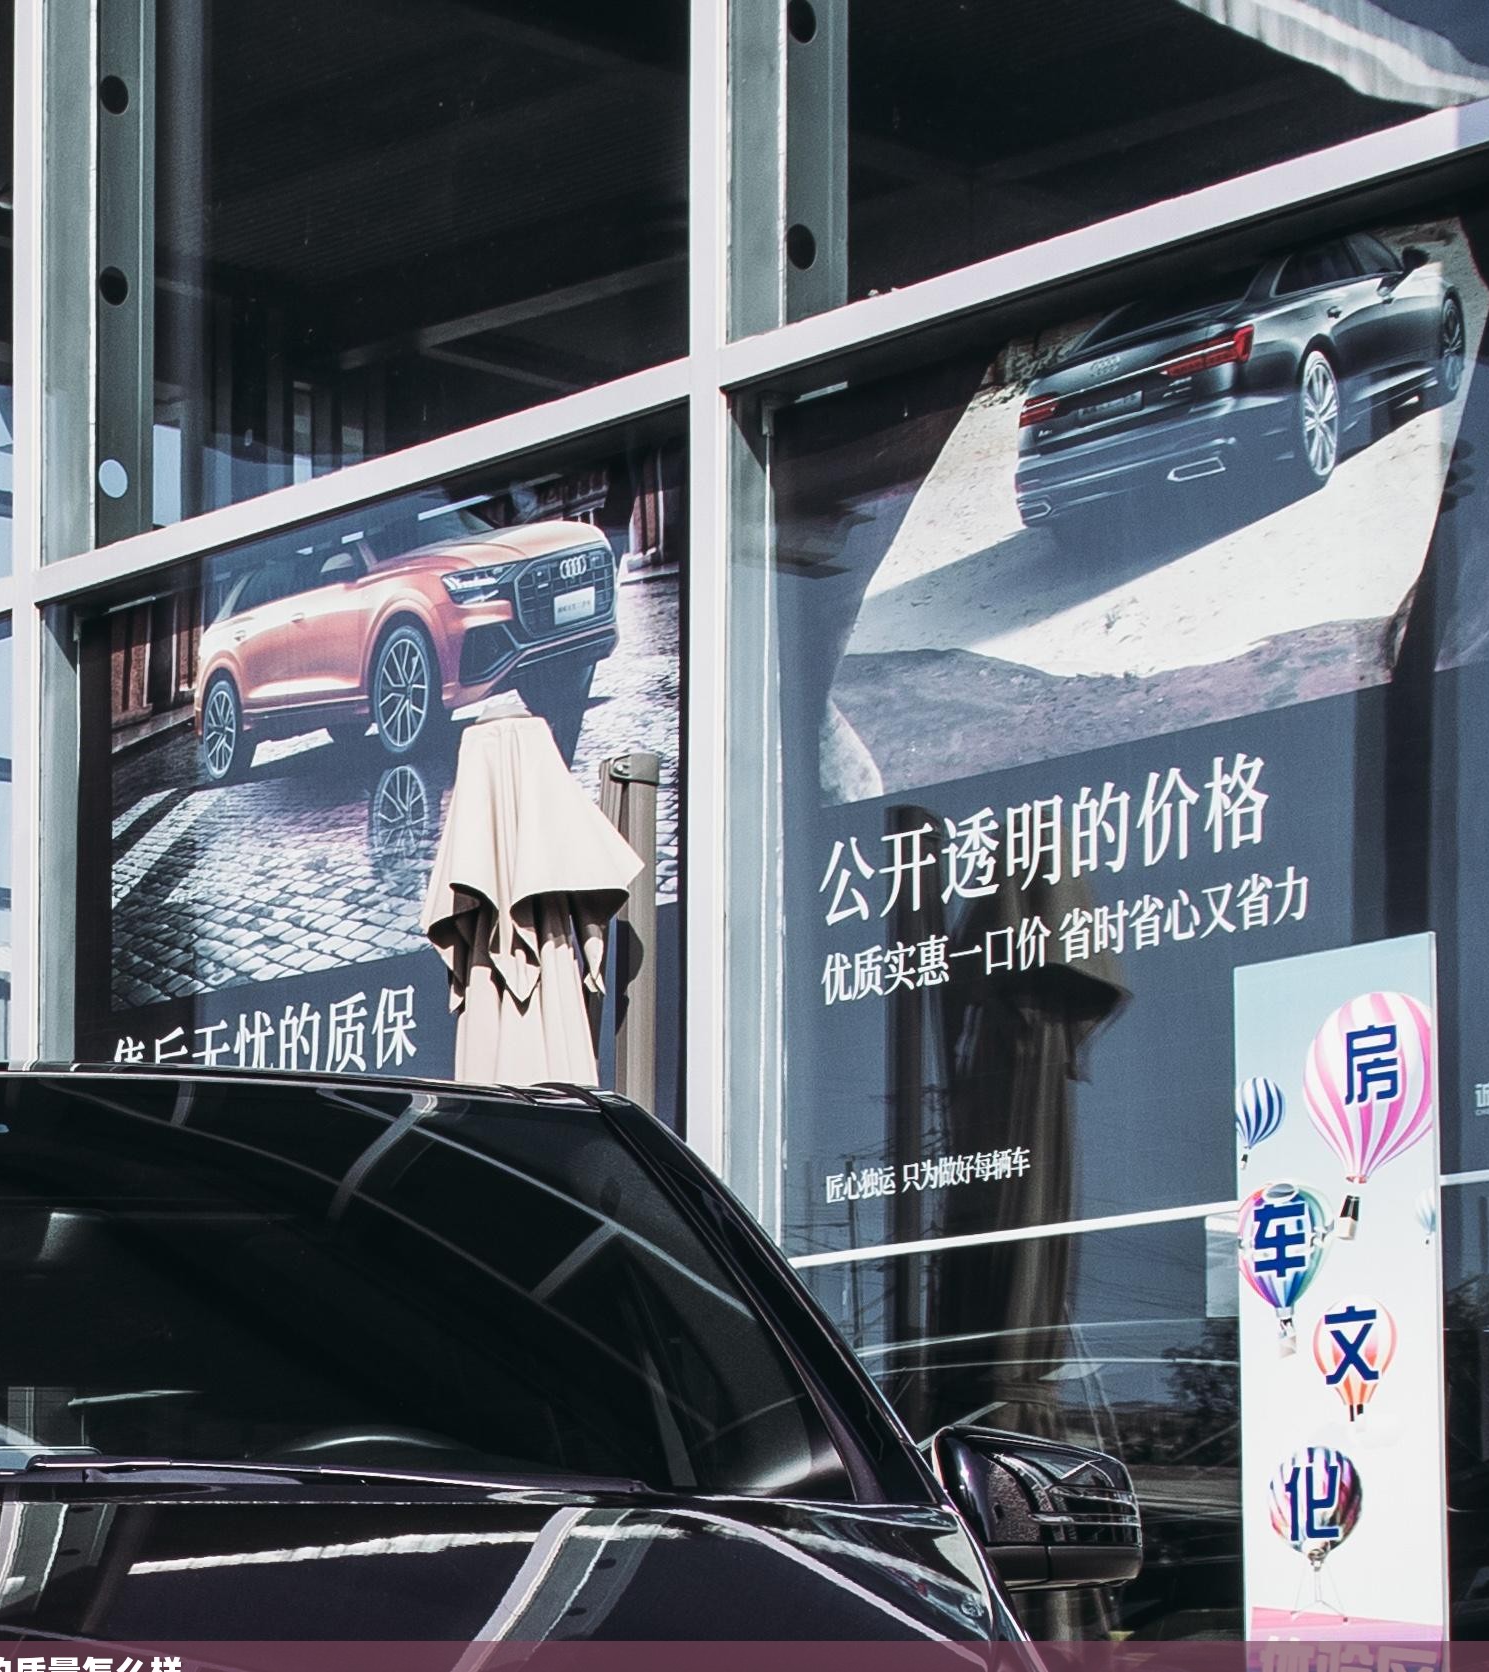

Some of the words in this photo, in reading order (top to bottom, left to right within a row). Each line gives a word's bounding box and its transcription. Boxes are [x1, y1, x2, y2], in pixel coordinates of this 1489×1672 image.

[819, 751, 1271, 928] 公开透明的价格
[821, 912, 1052, 1006] 优质实惠一口价
[1057, 864, 1310, 966] 省时省心又省力
[824, 1164, 897, 1204] 匠心独运
[900, 1145, 1032, 1194] 只为做好每辆车
